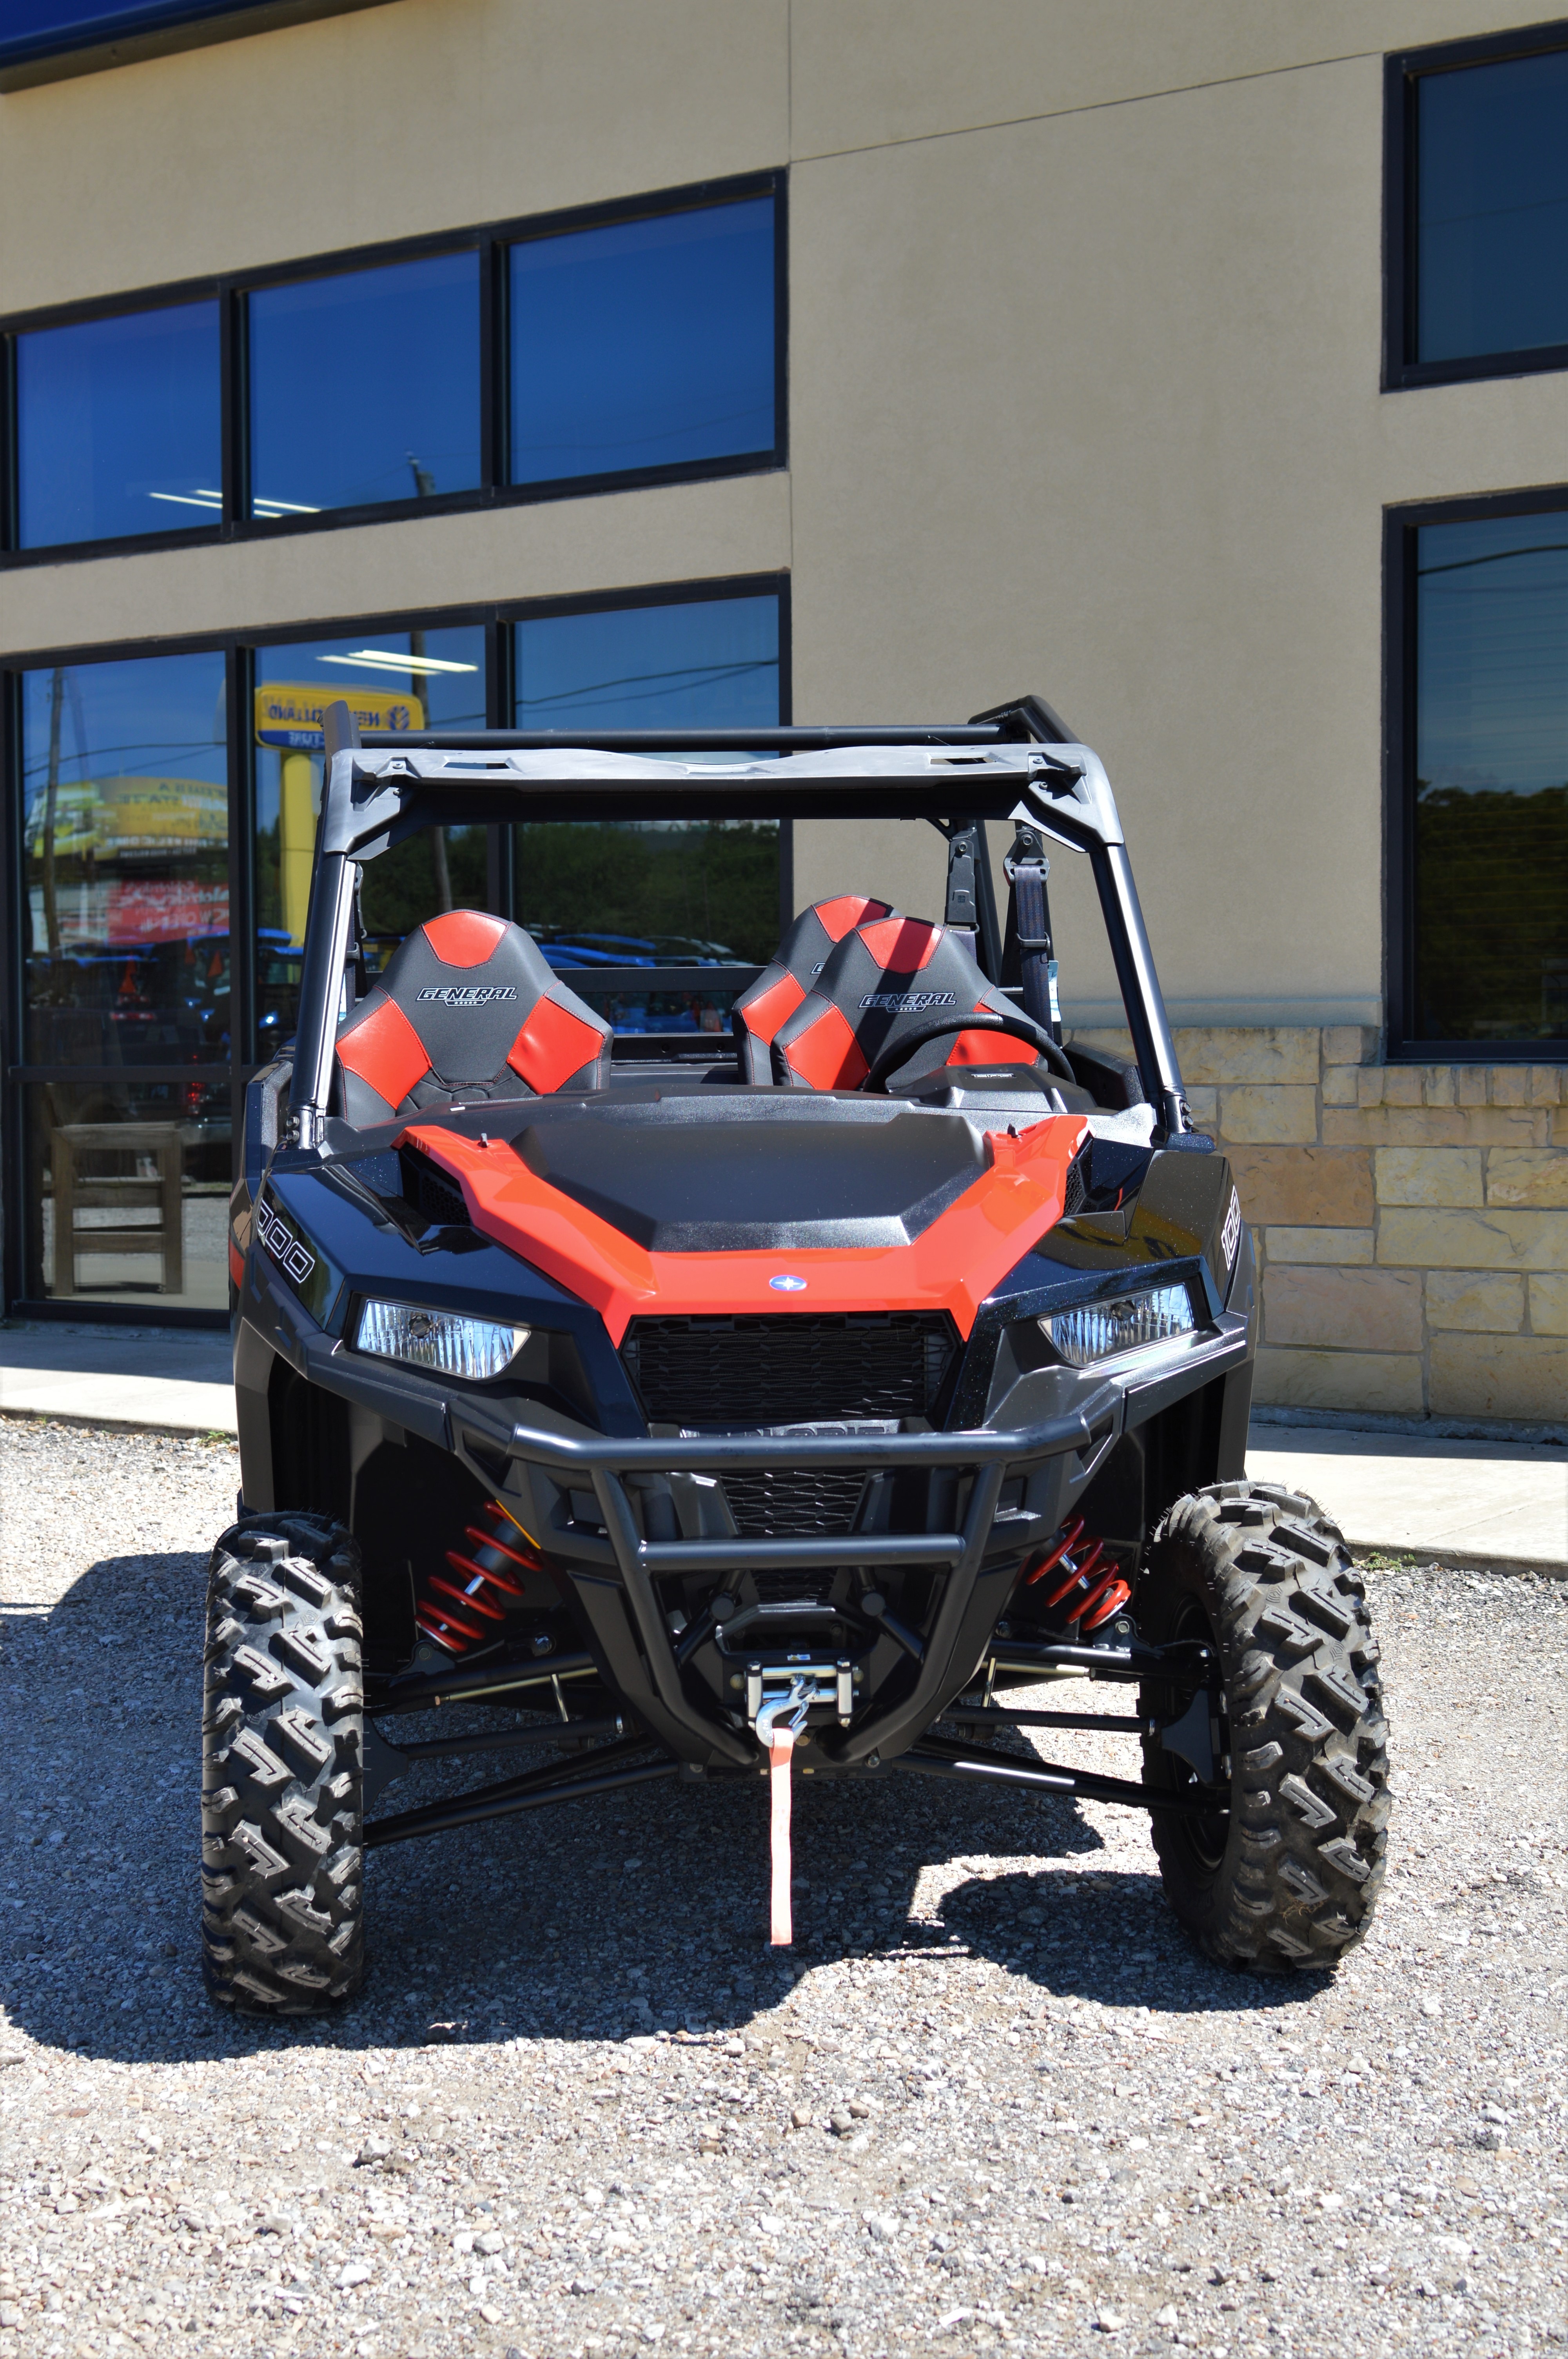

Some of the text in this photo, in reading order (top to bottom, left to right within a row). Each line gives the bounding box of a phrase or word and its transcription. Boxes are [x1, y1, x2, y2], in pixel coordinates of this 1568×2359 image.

[416, 987, 518, 1001] GENERAL
[858, 992, 956, 1008] GENERAL
[256, 1197, 316, 1284] 000
[1221, 1185, 1241, 1271] 100
